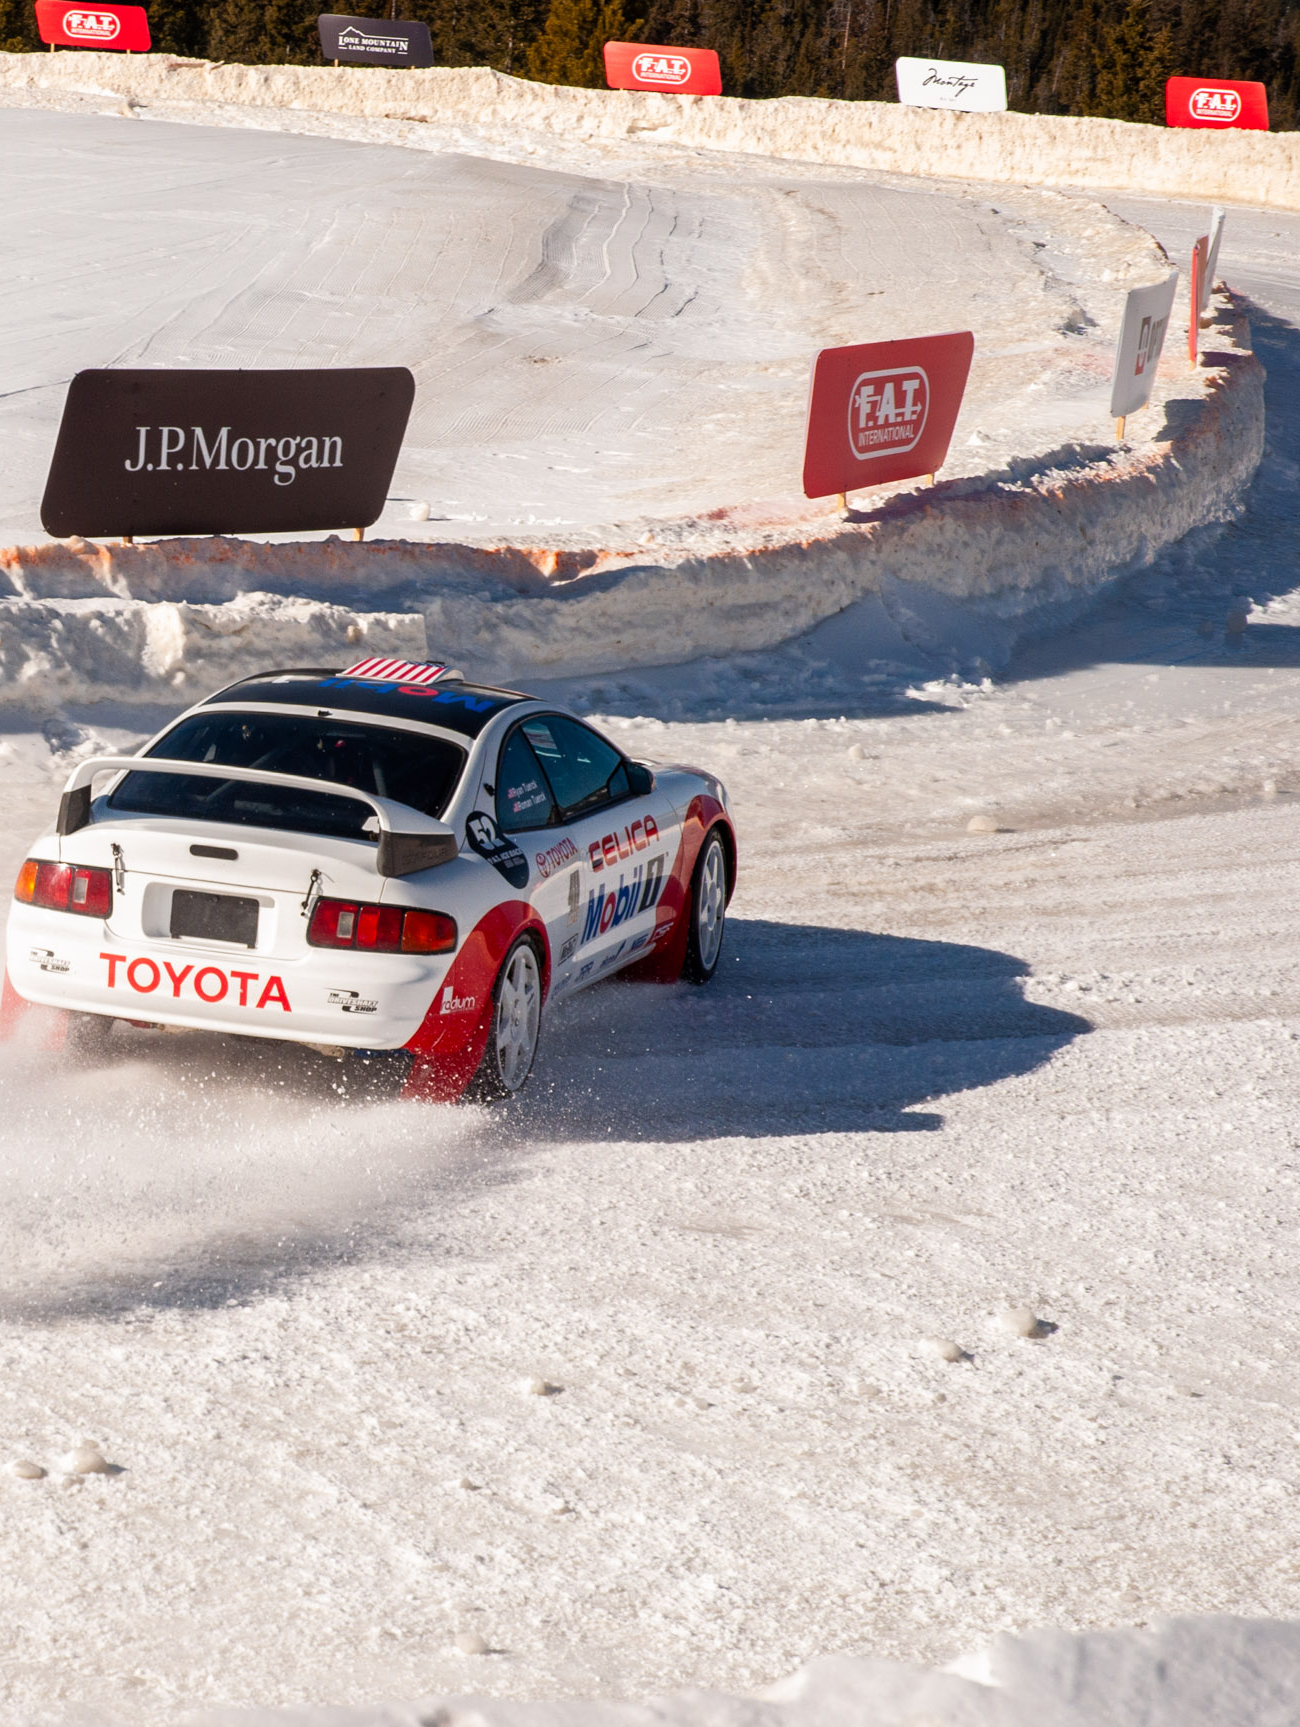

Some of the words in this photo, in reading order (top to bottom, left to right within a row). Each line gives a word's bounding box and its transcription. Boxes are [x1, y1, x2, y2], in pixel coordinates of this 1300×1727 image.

[71, 14, 114, 31] F.A.T.
[338, 36, 360, 46] LONE
[361, 38, 409, 51] MOUNTAIN
[366, 46, 397, 54] COMPANY
[641, 57, 684, 74] F.A.T.
[922, 68, 978, 97] Montage
[1197, 93, 1236, 110] F.A.T.
[859, 379, 920, 428] F.A.T.
[858, 424, 914, 447] INTERNATIONAL
[124, 426, 344, 486] J.P.Morgan
[468, 815, 506, 850] 52
[588, 814, 660, 873] CELICA
[546, 837, 578, 869] TOYOTA
[581, 864, 643, 945] Mobil
[637, 853, 665, 913] 1
[100, 952, 292, 1012] TOYOTA
